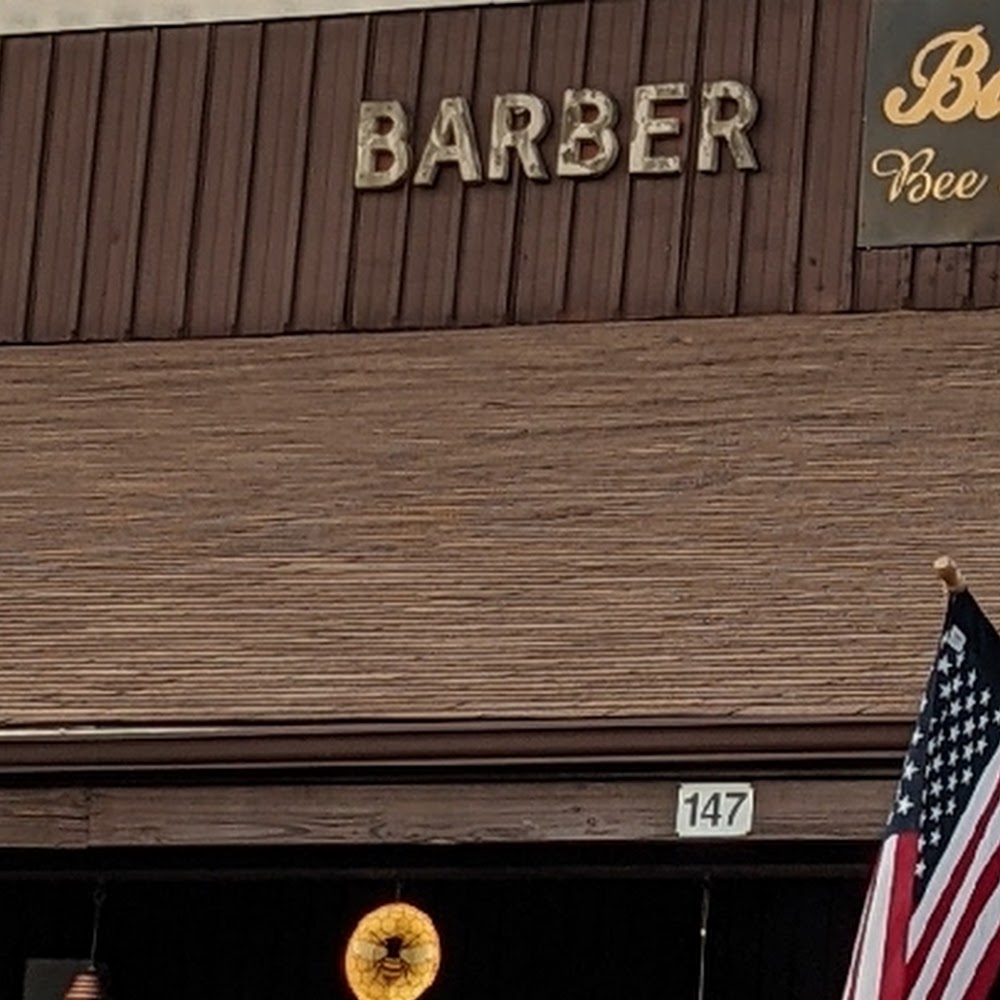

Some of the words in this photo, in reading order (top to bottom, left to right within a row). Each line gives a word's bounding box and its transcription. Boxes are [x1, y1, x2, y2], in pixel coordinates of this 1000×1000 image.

[355, 80, 759, 190] BARBER
[871, 147, 988, 204] Bee
[683, 792, 749, 828] 147
